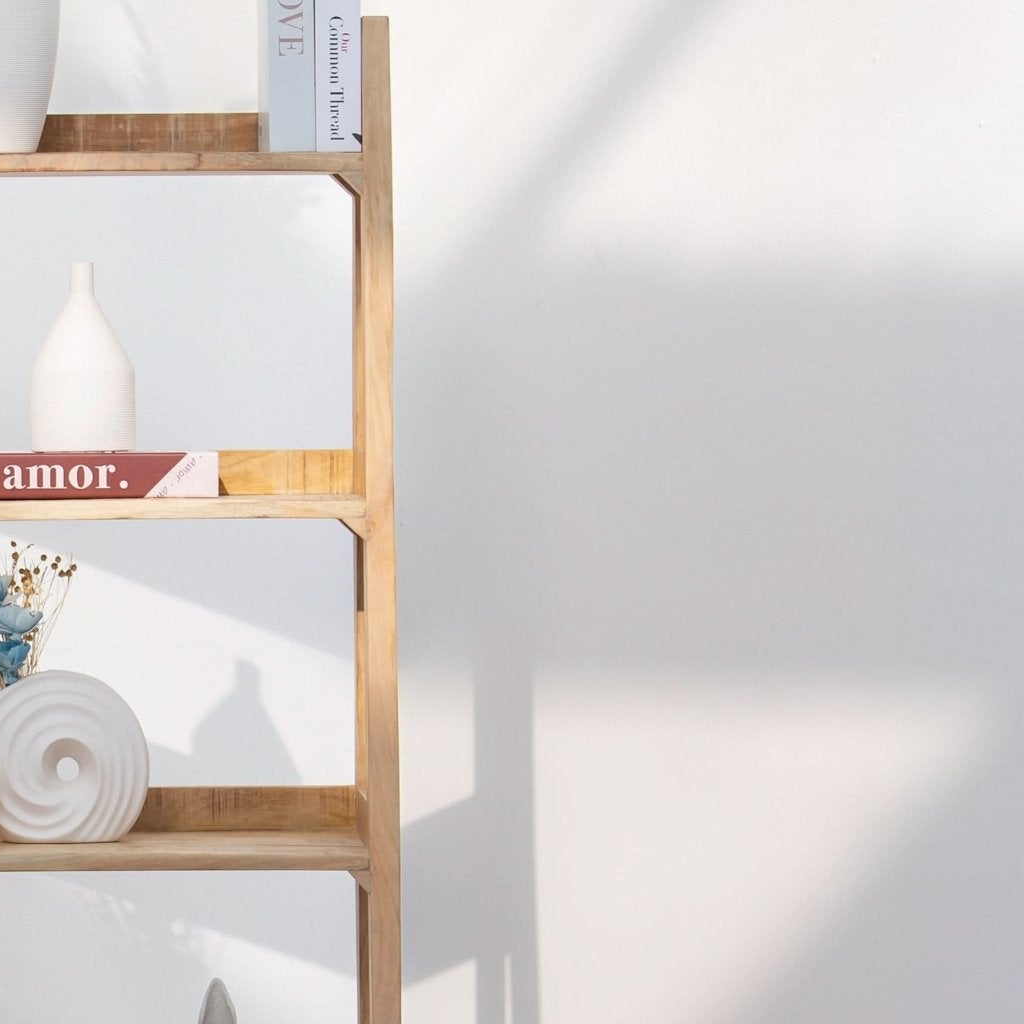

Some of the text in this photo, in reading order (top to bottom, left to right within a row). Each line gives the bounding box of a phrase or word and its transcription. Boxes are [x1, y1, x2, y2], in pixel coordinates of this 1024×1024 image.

[341, 33, 351, 53] Our
[329, 16, 345, 140] Common Thread
[3, 463, 129, 490] amor.
[176, 457, 198, 483] amor
